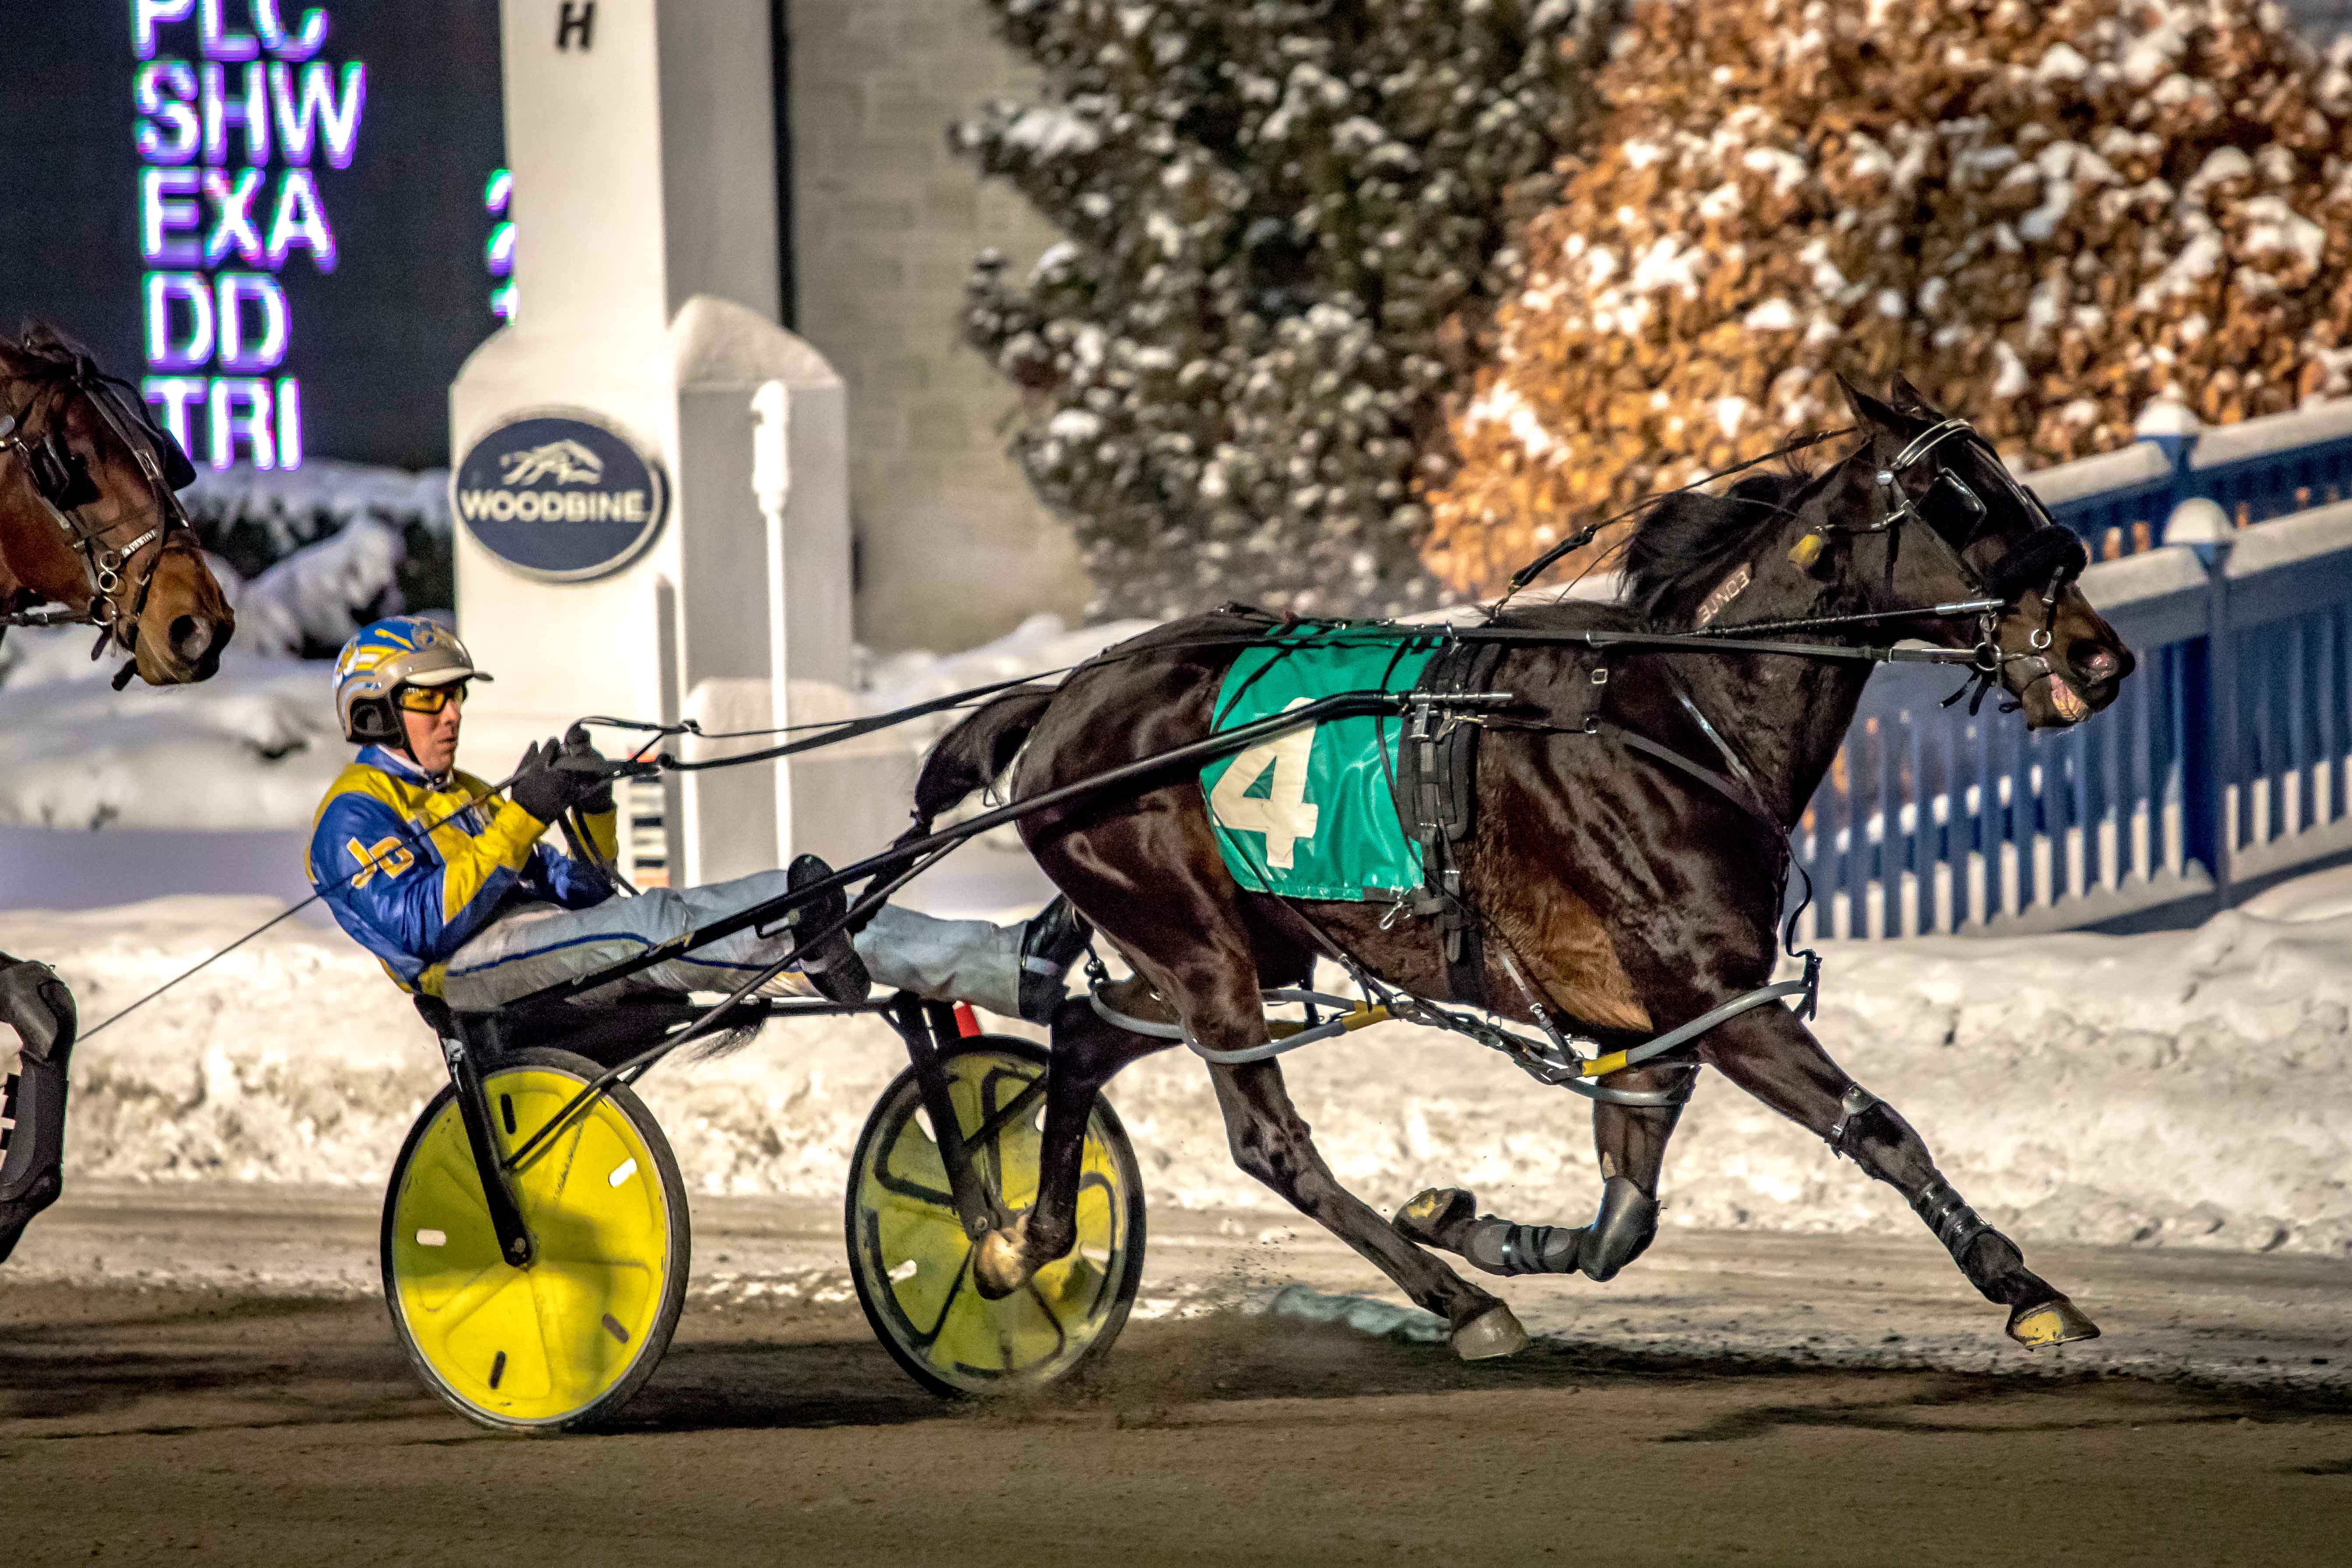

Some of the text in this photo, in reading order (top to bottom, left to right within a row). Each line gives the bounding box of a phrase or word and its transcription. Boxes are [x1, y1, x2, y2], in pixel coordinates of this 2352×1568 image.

[130, 0, 327, 61] PLC
[134, 60, 366, 169] SHW
[138, 166, 337, 272] EXA
[142, 271, 291, 372] DD
[142, 376, 302, 471] TRI
[460, 489, 647, 522] WOODBINE
[1210, 697, 1319, 869] 4
[346, 836, 414, 889] JD
